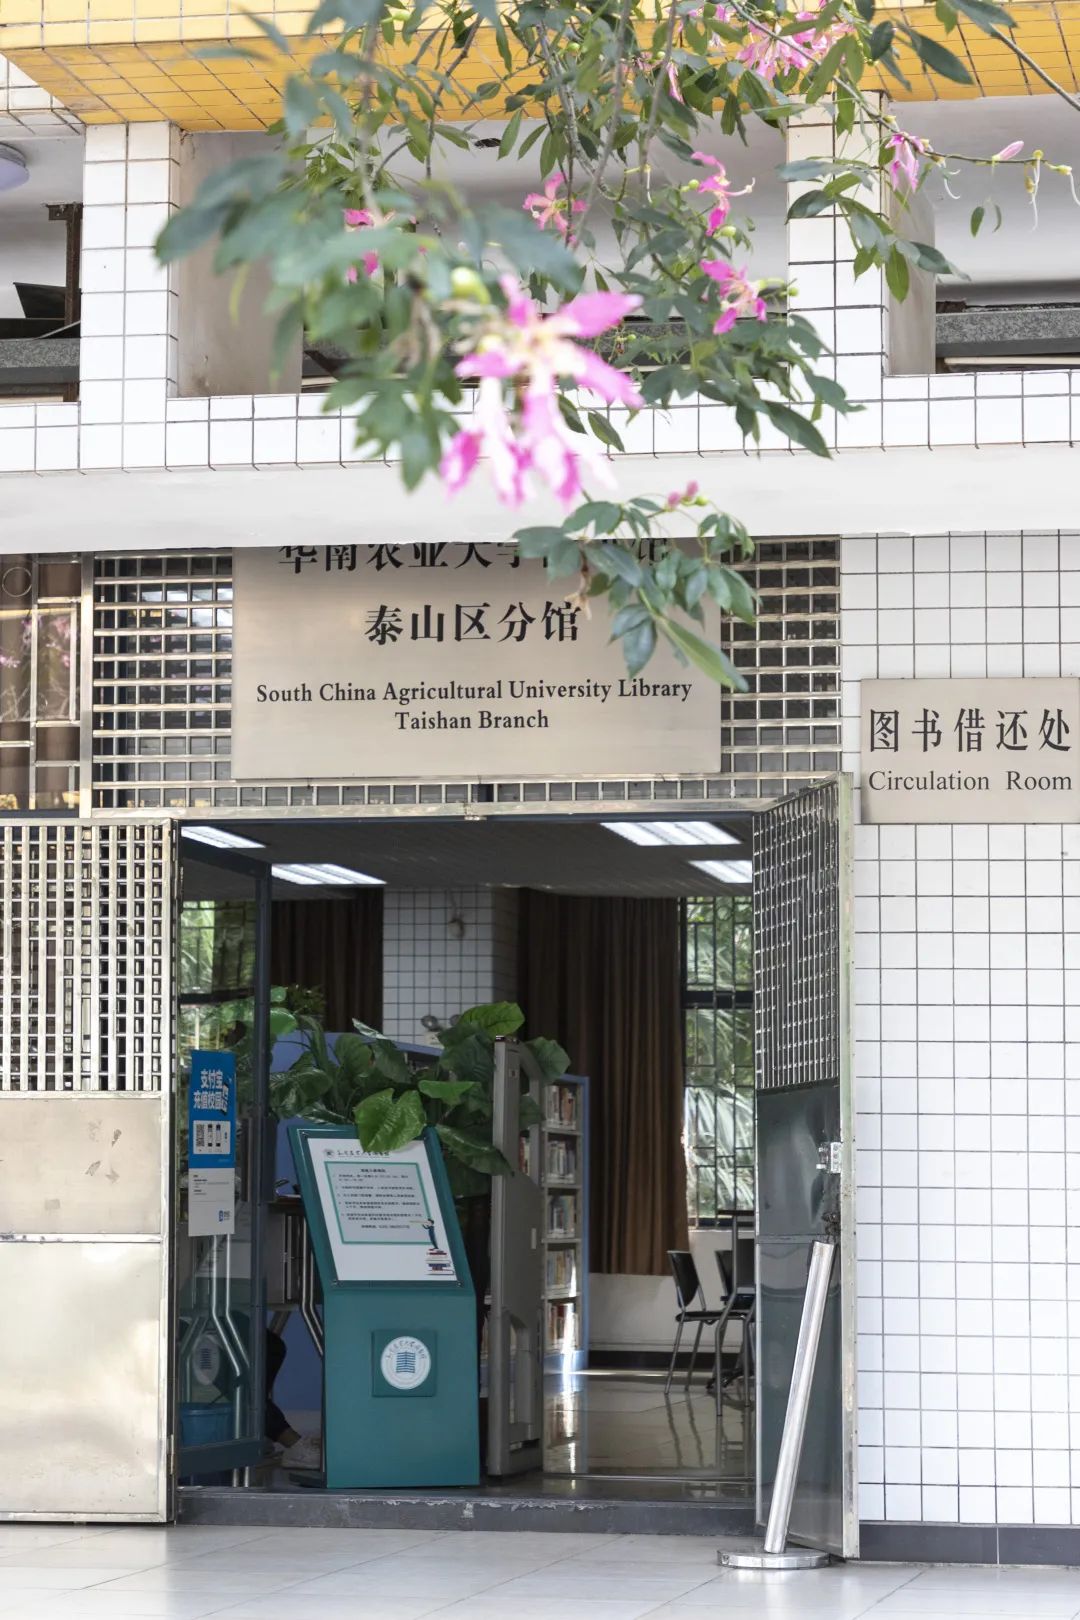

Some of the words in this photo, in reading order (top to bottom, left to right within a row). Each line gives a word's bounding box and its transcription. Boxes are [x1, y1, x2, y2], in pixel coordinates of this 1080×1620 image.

[365, 600, 582, 646] 泰山区分馆
[256, 683, 313, 703] South
[319, 682, 376, 702] China
[382, 680, 502, 706] Agricultural
[508, 678, 612, 704] University
[618, 676, 693, 702] Library
[394, 710, 472, 730] Taishan
[478, 709, 549, 729] Branch
[869, 708, 1071, 753] 图书借还处
[868, 770, 990, 791] Circulation
[1006, 770, 1073, 791] Room
[200, 1069, 224, 1089] 支付宝
